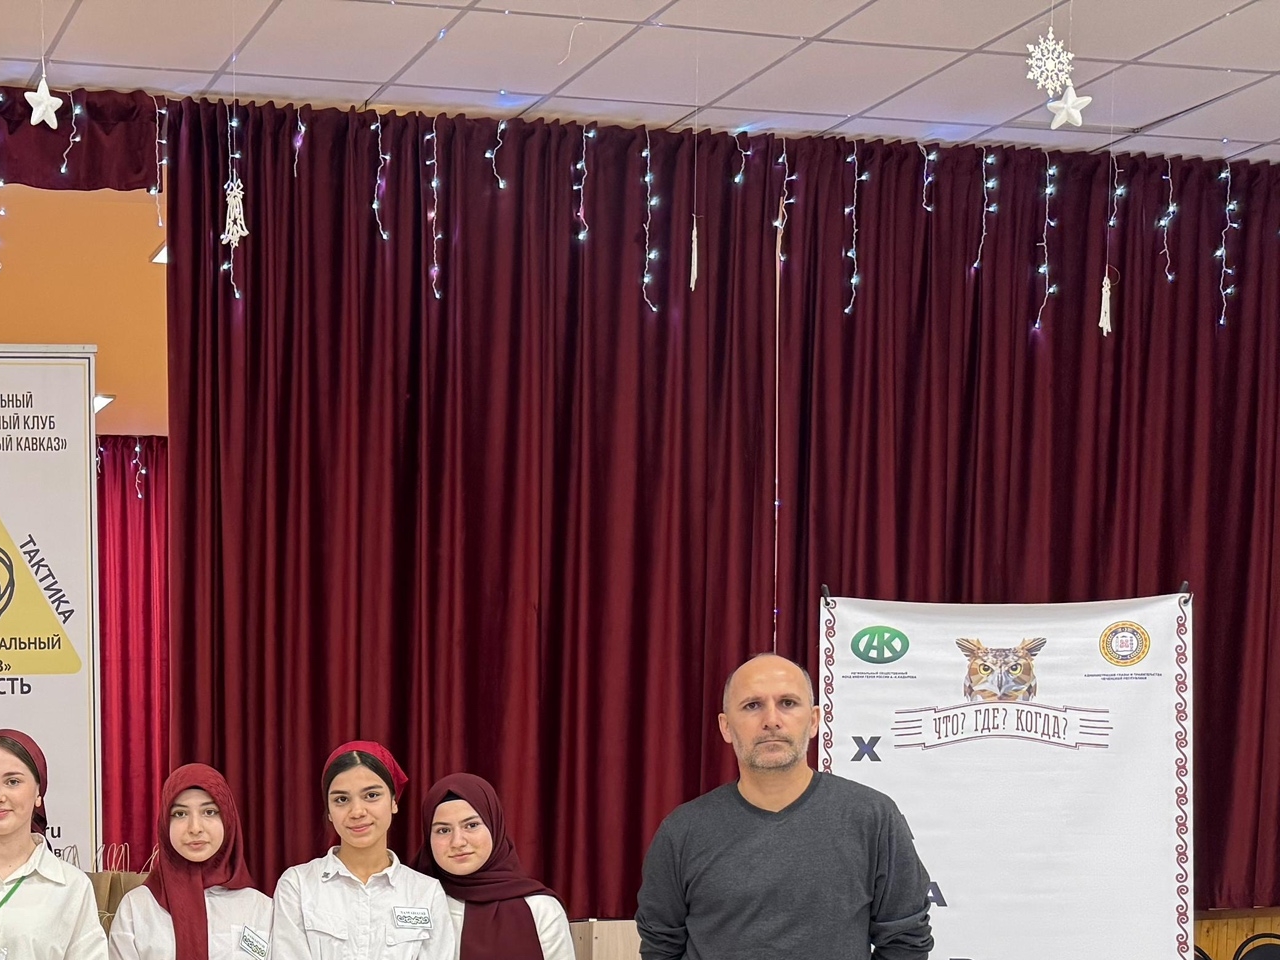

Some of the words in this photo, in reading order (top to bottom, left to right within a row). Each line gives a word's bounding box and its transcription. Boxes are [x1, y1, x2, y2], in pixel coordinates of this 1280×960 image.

[23, 415, 56, 430] КЛУБ
[16, 436, 68, 451] КАВКАЗ»
[20, 534, 75, 625] ТАКТИКА
[933, 712, 967, 740] ЧТО?
[974, 708, 1008, 733] ГДЕ?
[1015, 708, 1069, 740] КОГДА?
